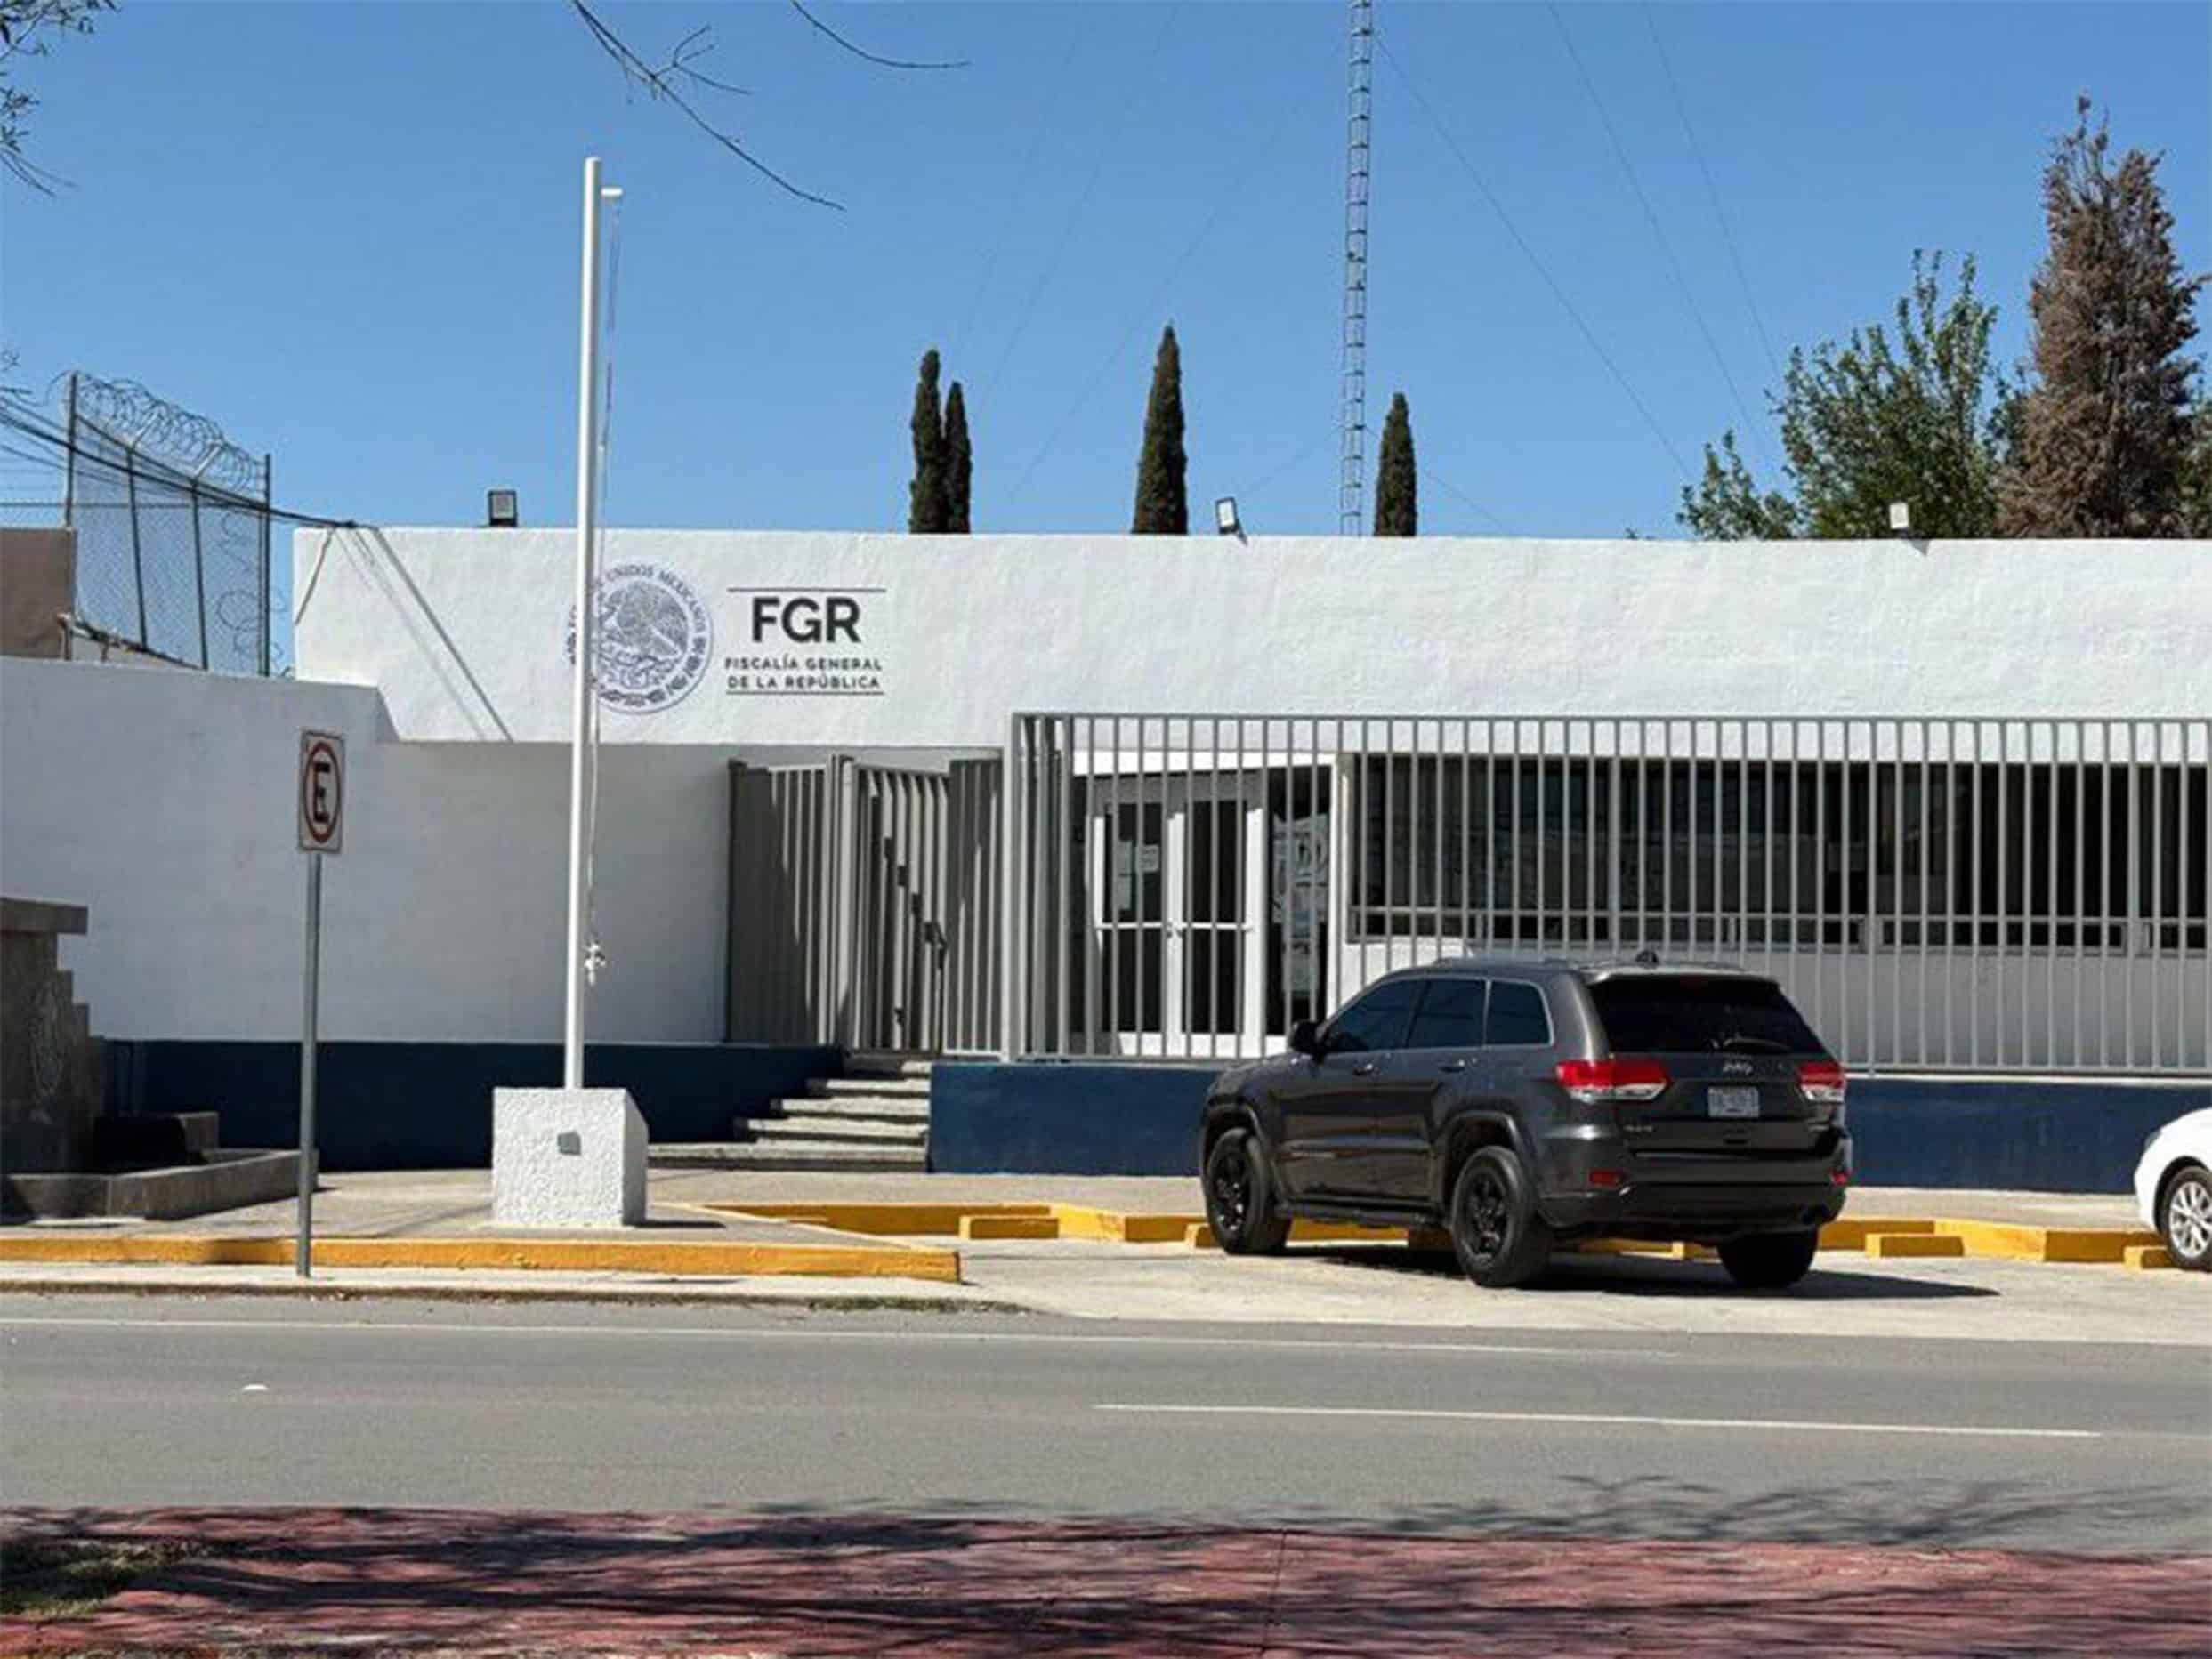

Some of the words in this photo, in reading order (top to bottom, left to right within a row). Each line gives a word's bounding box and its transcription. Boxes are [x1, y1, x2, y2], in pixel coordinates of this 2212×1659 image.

[751, 596, 861, 643] FGR
[724, 654, 799, 671] FISCALÍA
[804, 656, 883, 672] GENERAL
[727, 675, 749, 689] DE
[756, 675, 778, 689] LA
[784, 672, 880, 689] REPÚBLICA
[312, 761, 331, 824] E
